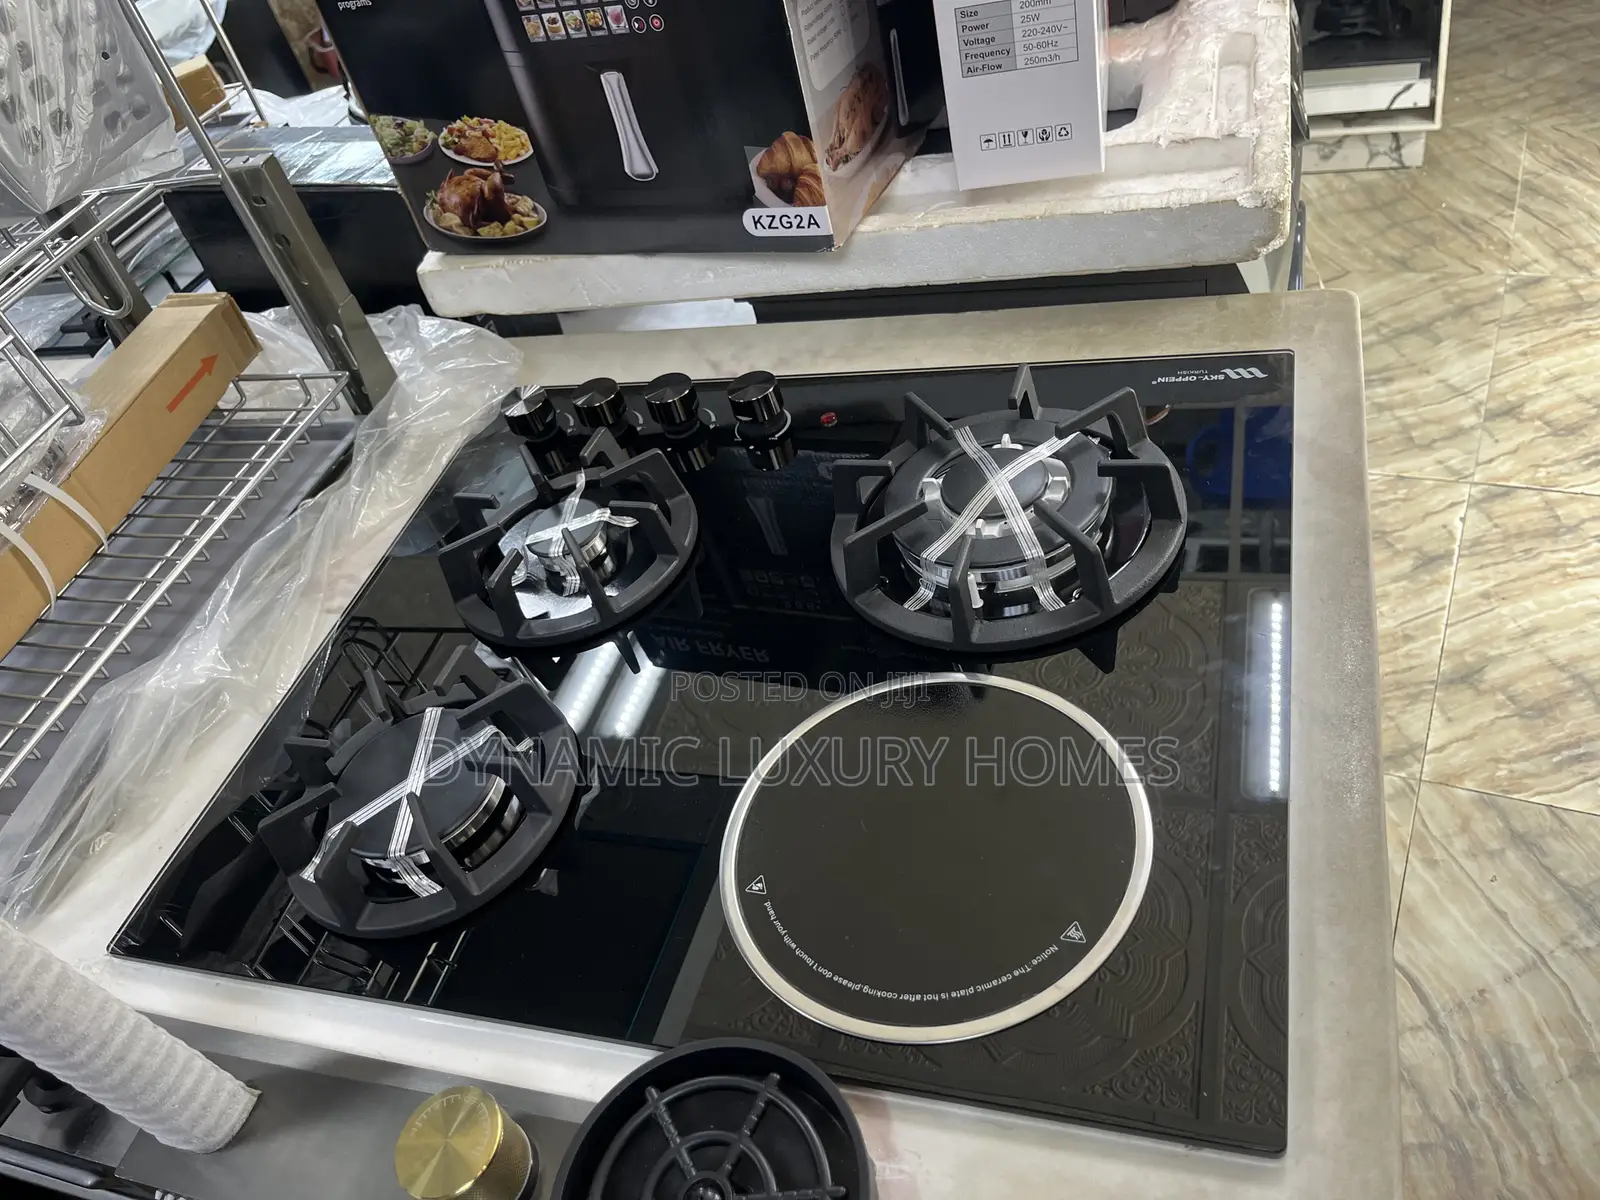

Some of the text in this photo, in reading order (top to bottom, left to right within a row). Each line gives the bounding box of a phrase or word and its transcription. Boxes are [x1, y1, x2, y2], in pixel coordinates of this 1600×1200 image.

[337, 0, 373, 11] programs
[960, 0, 1052, 19] Size 200mm
[961, 13, 1041, 33] Power 25W
[963, 24, 1068, 47] Voltage 220-240V~
[964, 40, 1059, 60] Frequency 50-60Hz
[966, 53, 1061, 74] Air-Flow 250m3/h
[751, 213, 821, 230] KZG2A
[773, 920, 788, 936] your
[783, 934, 797, 950] with
[795, 947, 815, 967] touch
[975, 973, 1013, 992] ceramic
[899, 993, 922, 1003] after
[923, 993, 939, 1002] hot
[940, 991, 949, 1000] is
[950, 986, 974, 999] plate
